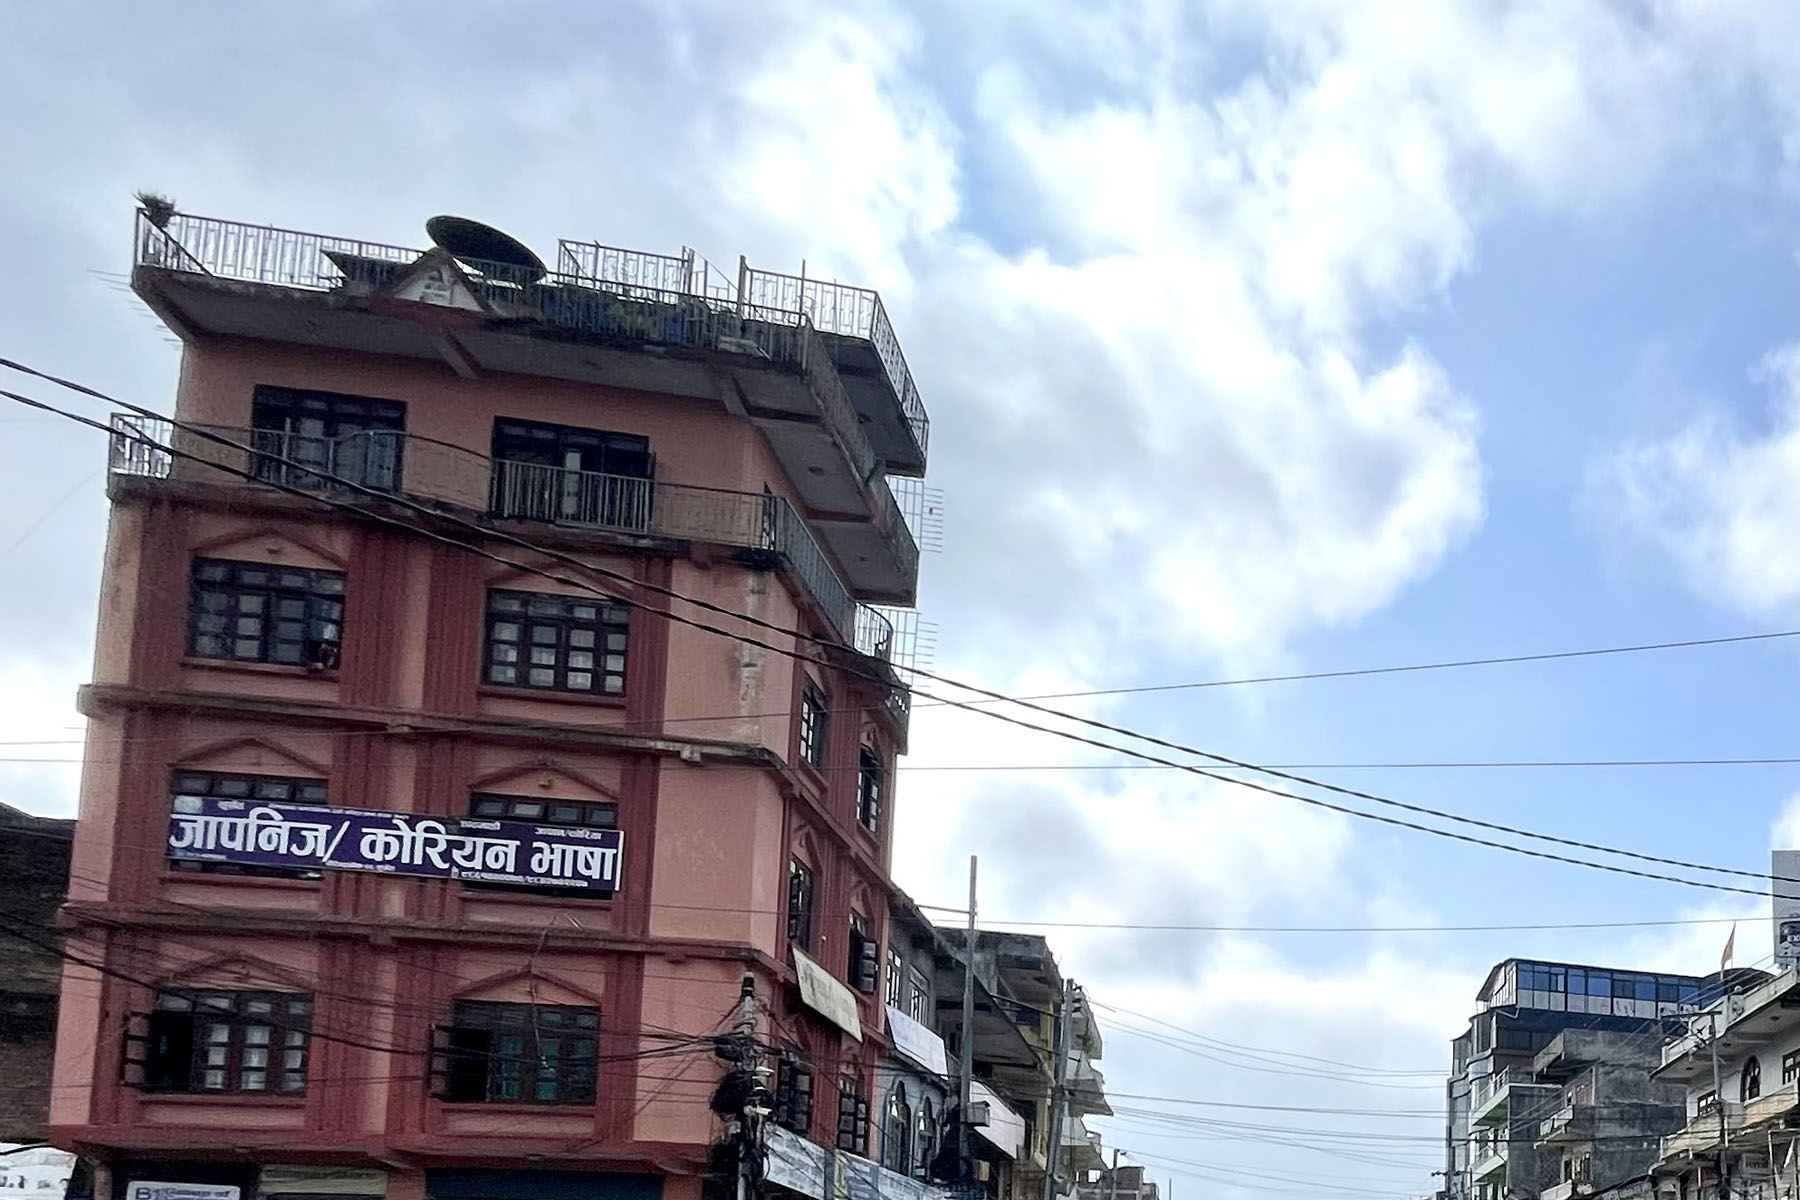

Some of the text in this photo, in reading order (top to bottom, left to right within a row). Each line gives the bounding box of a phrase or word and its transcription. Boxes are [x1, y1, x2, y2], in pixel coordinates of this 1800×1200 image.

[169, 807, 350, 862] जापनिज/
[359, 819, 520, 873] कोरियन
[530, 841, 618, 880] भाषा
